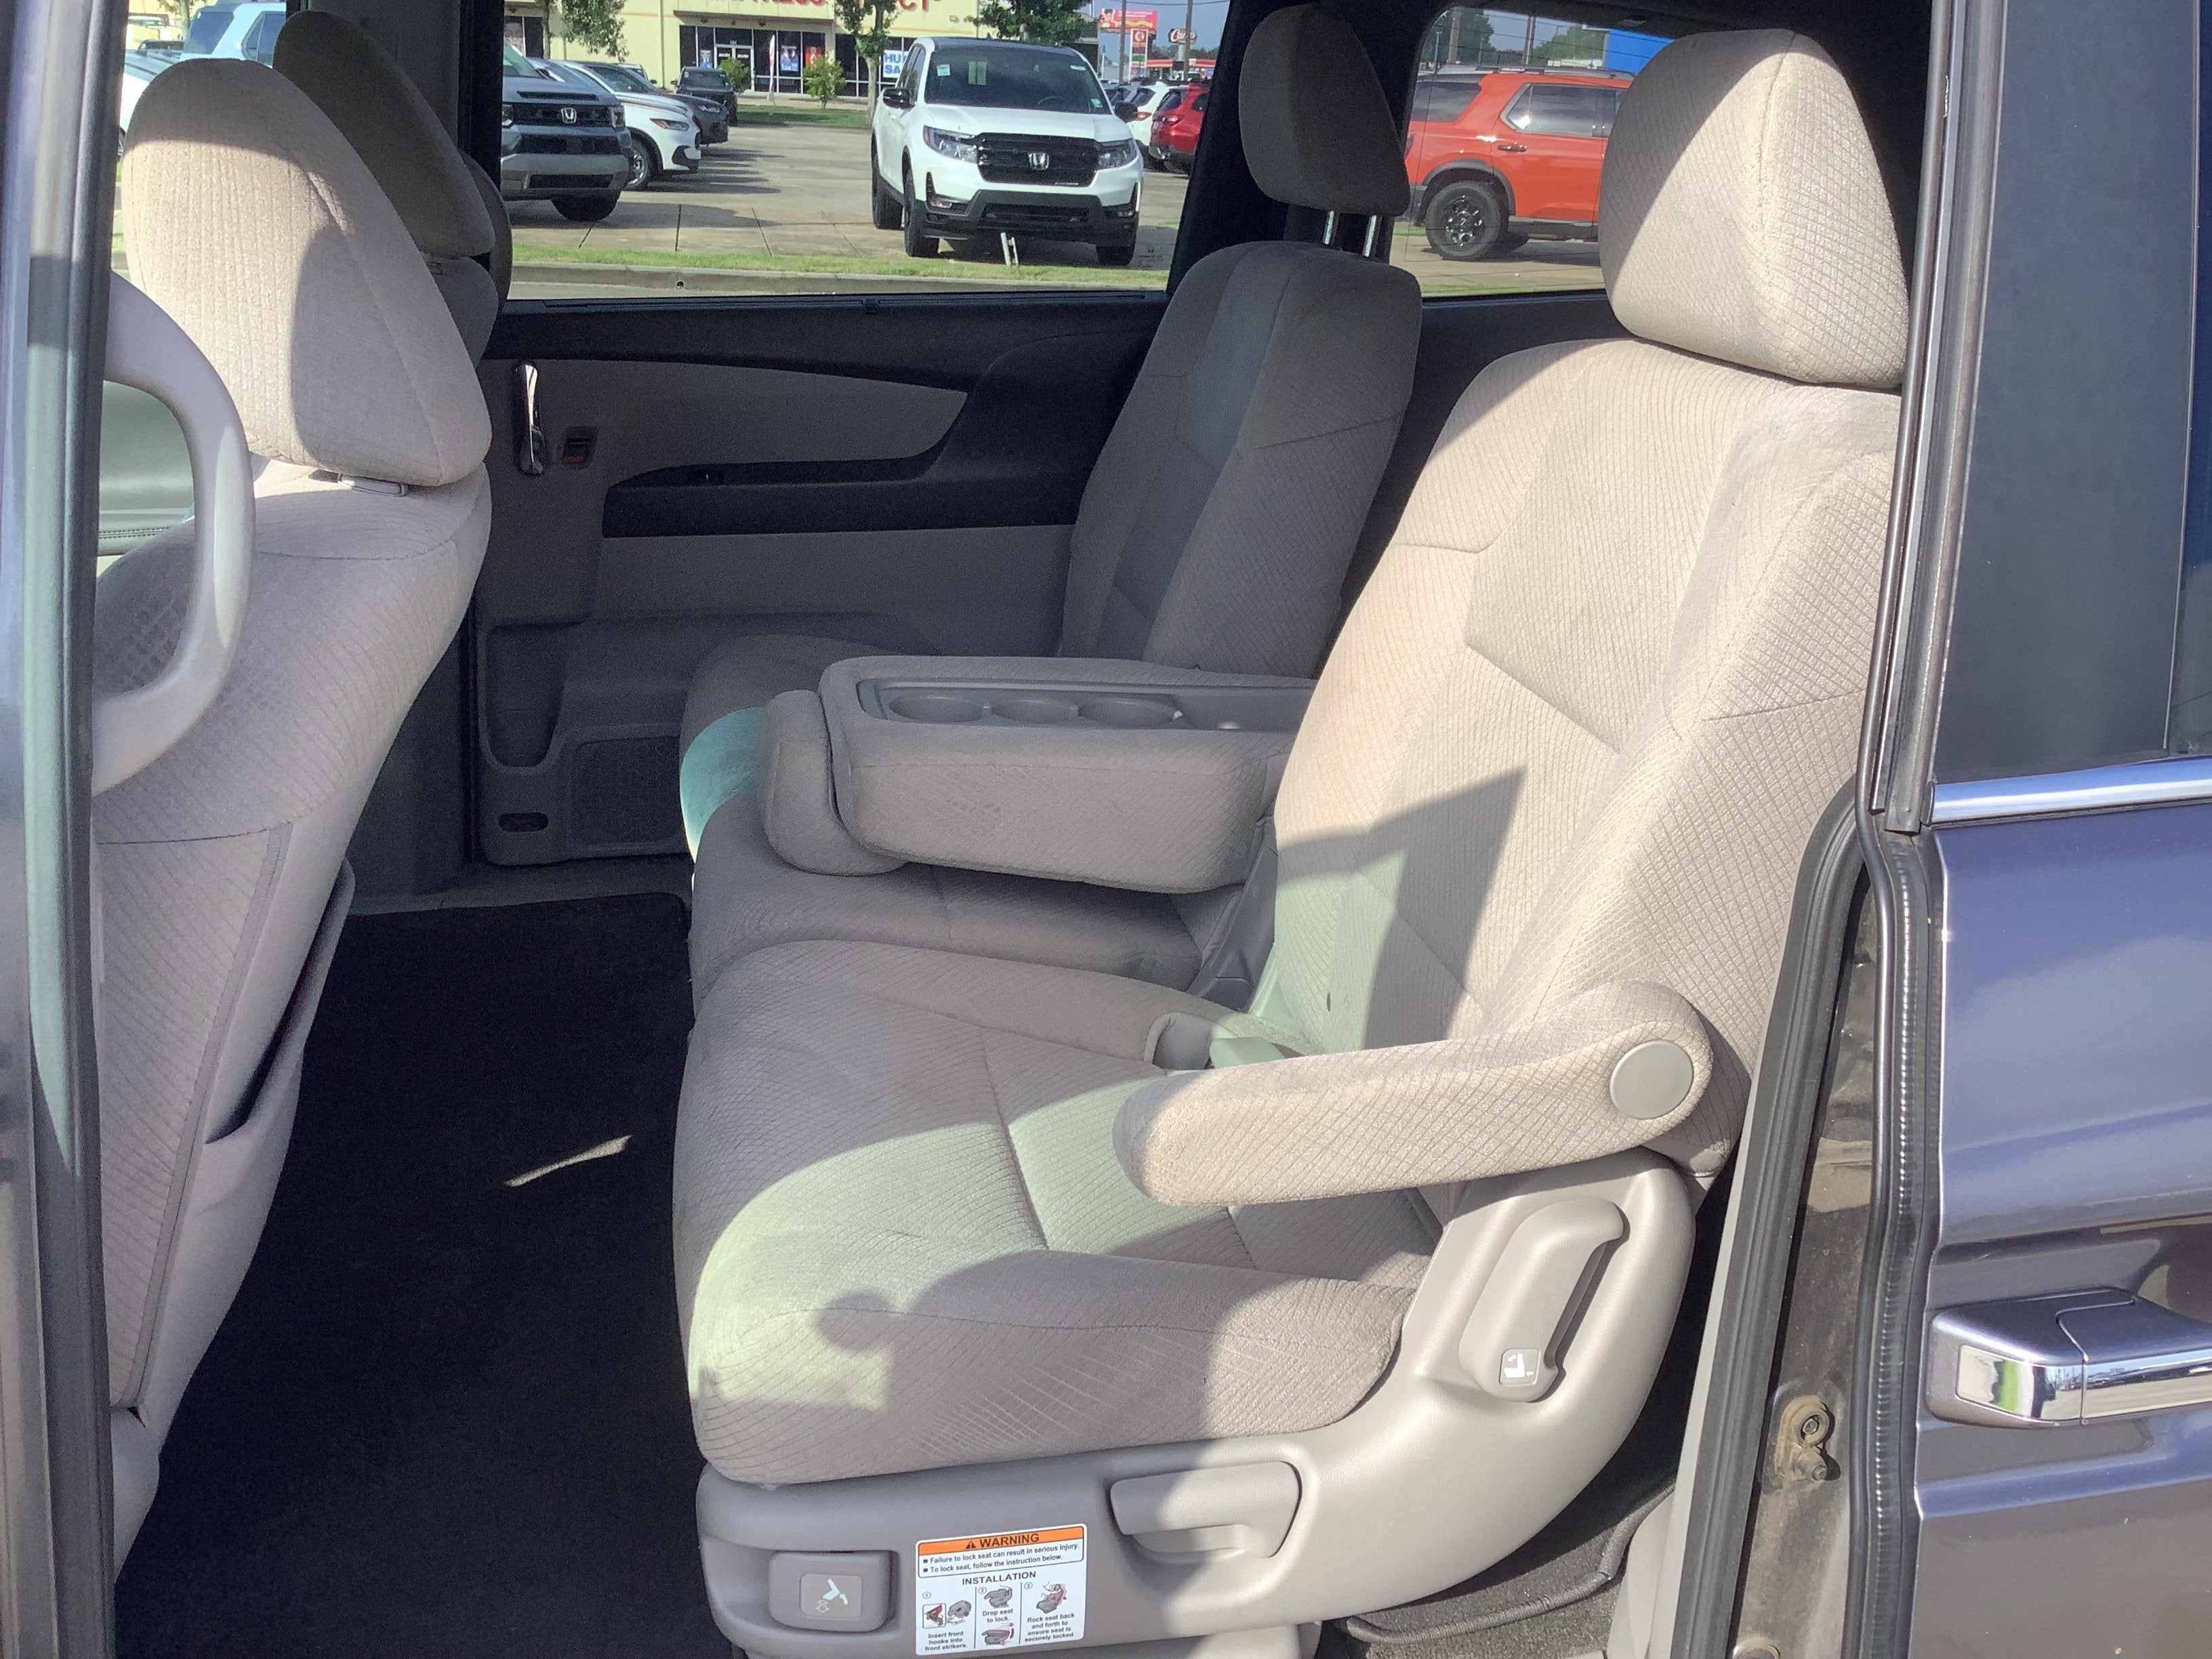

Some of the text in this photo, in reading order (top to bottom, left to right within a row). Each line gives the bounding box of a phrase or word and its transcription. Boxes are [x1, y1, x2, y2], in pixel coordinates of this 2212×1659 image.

[980, 1533, 1039, 1548] WARNING
[1059, 1543, 1080, 1551] injury.
[1006, 1557, 1040, 1565] instruction
[962, 1571, 1036, 1585] INSTALLATION
